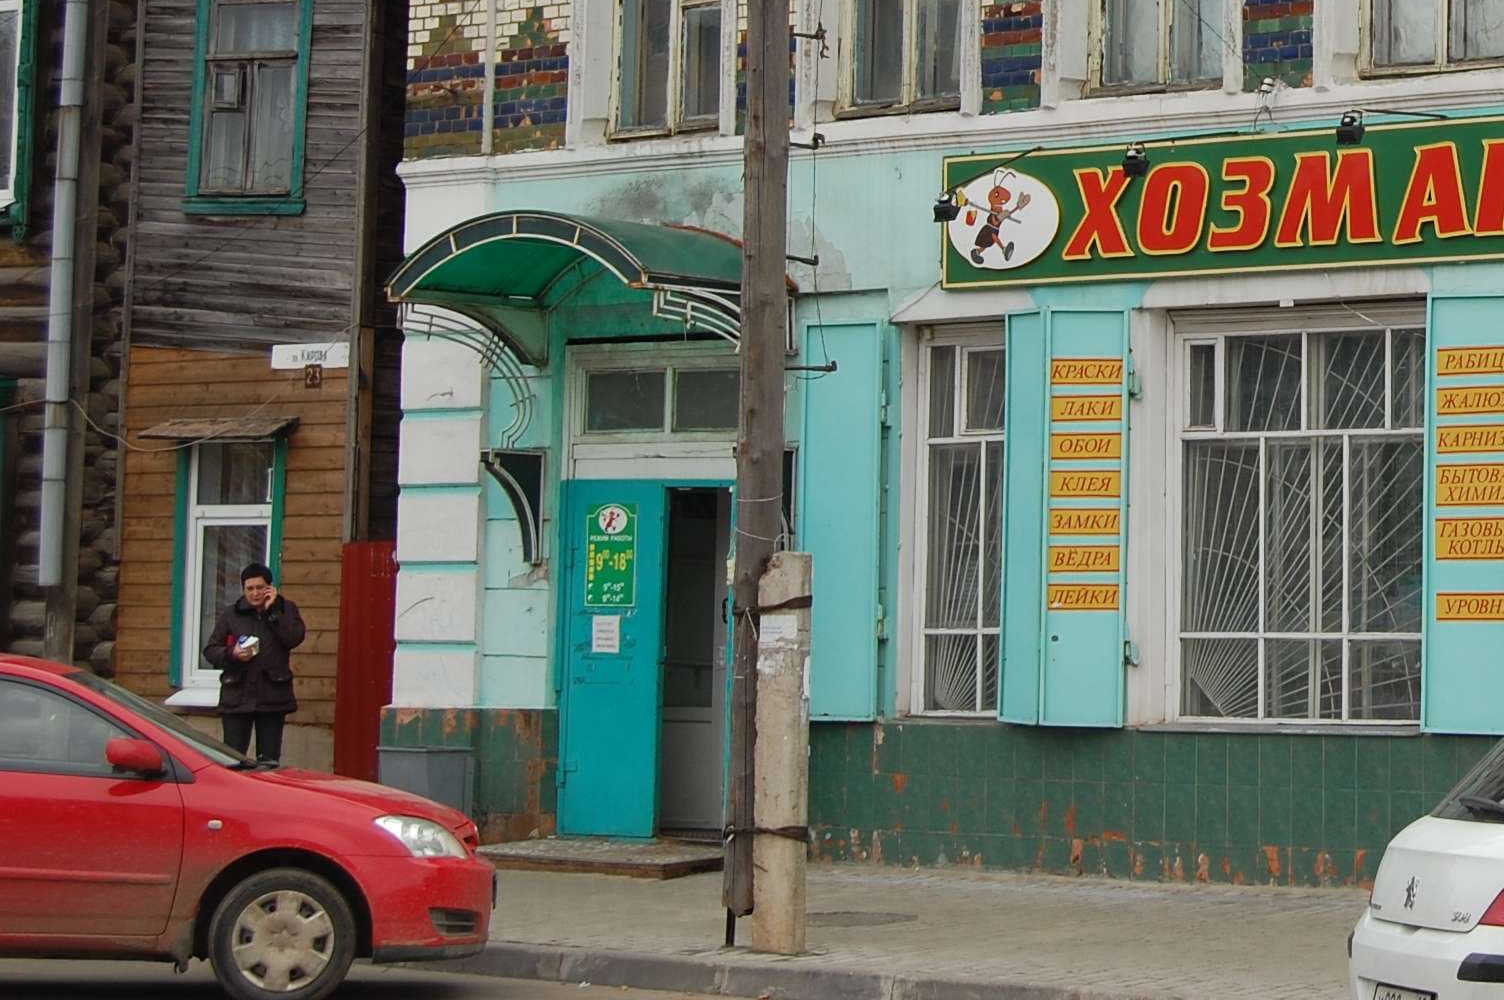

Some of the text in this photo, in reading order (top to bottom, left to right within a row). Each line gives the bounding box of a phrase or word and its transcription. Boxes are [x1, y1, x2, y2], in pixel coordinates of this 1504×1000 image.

[1052, 362, 1122, 381] КРАСКИ
[1060, 400, 1114, 417] ЛАКИ
[1059, 437, 1112, 454] ОБОИ
[1060, 476, 1112, 493] КЛЕЯ
[1053, 513, 1119, 530] ЗАМКИ
[1054, 549, 1112, 568] ВЁДРА
[1050, 583, 1118, 605] ЛЕЙКИ
